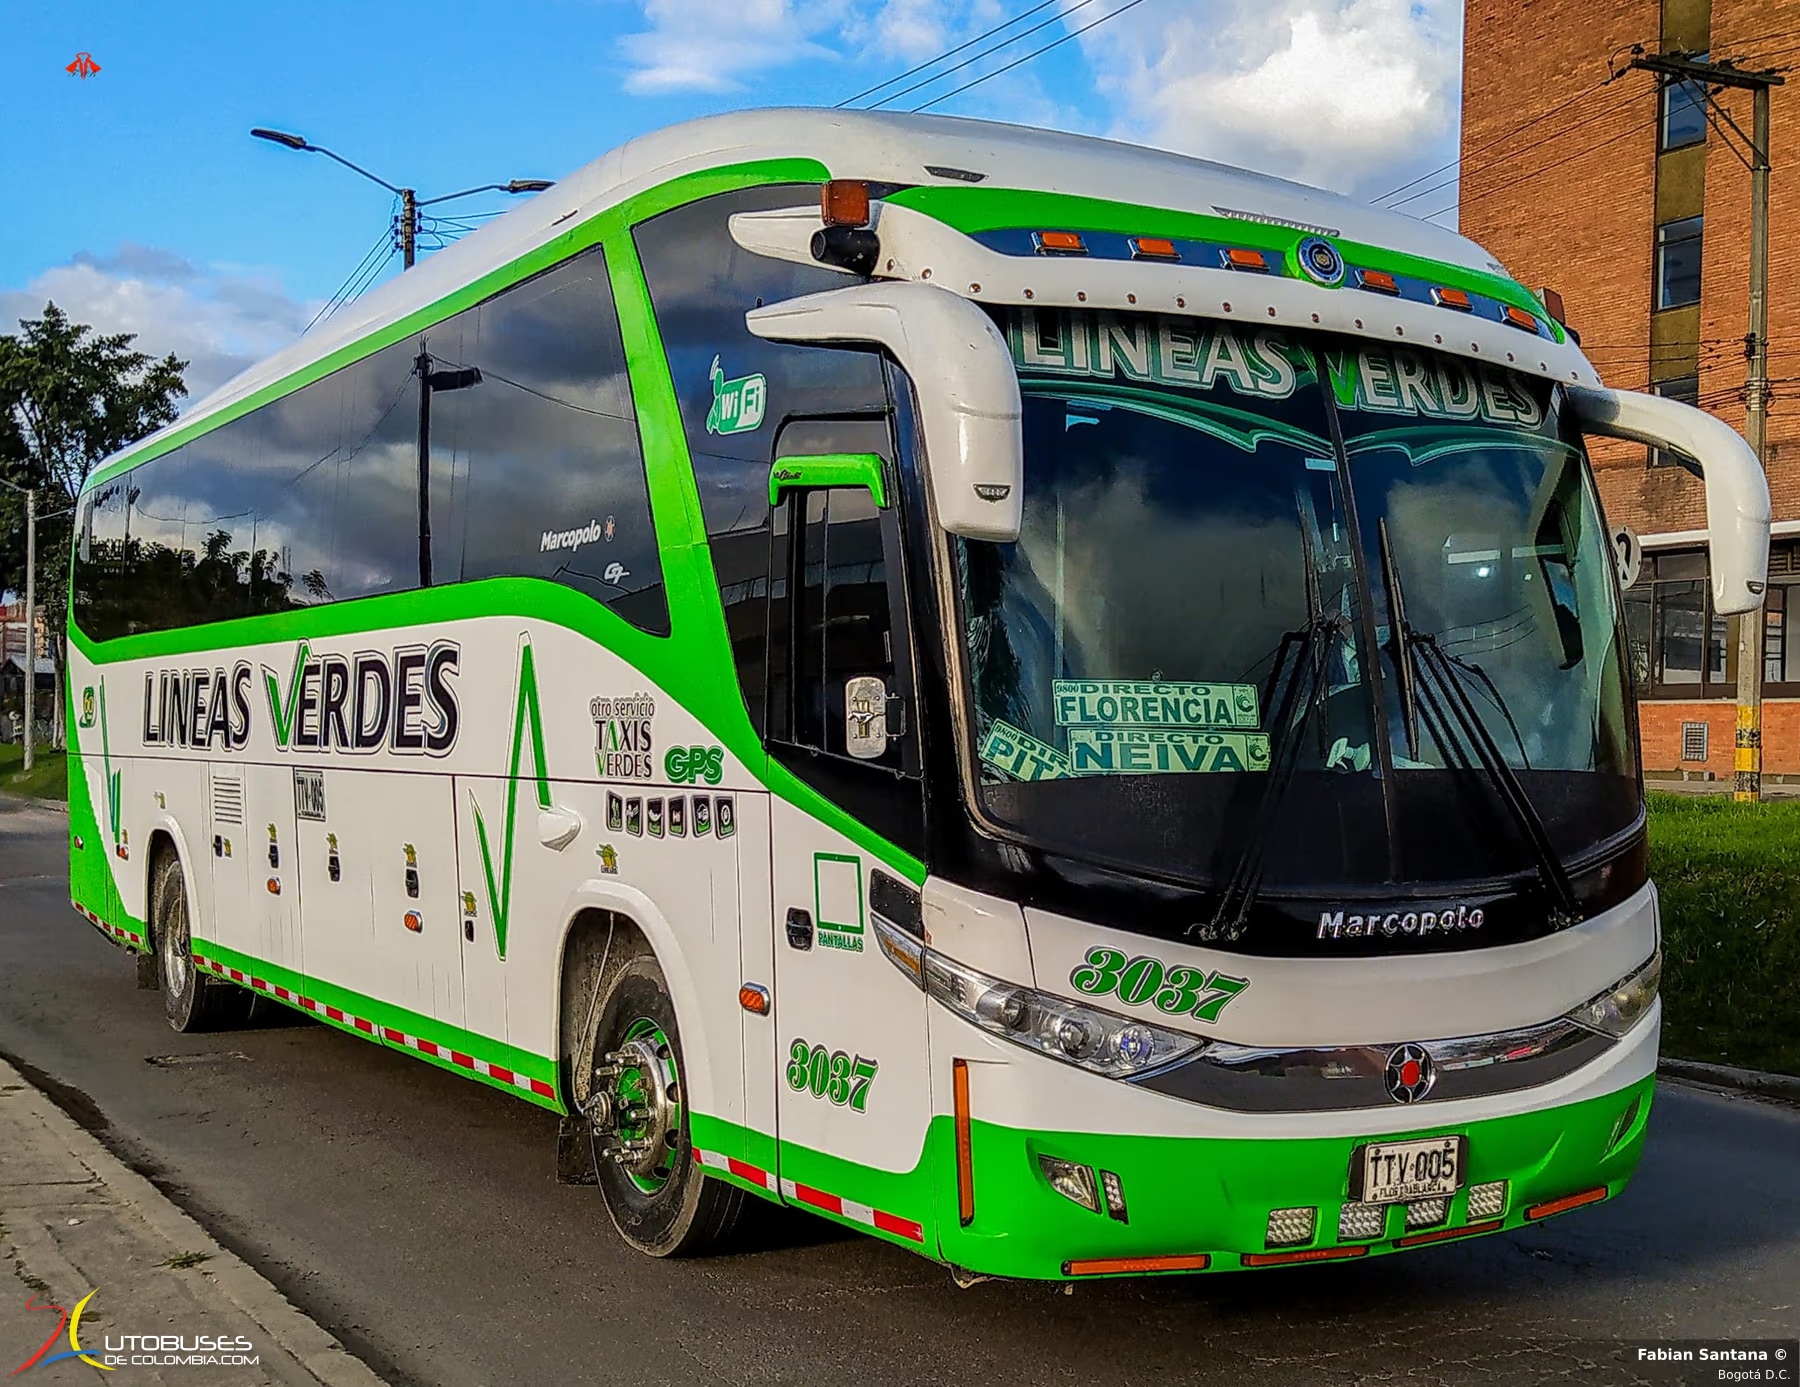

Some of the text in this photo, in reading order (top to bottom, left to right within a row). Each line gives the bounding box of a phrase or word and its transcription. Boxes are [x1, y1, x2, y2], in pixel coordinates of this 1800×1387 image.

[1012, 308, 1543, 430] LINEAS VERDES
[540, 519, 601, 552] Marcopolo
[143, 639, 461, 757] LINEAS VERDES
[1080, 684, 1212, 696] DIRECTO
[591, 697, 655, 717] otro servicio
[1060, 696, 1233, 724] FLORENCIA
[595, 720, 652, 752] TAXIS
[1095, 731, 1224, 745] DIRECTO
[597, 750, 652, 778] VERDES
[665, 746, 723, 784] GPS
[985, 736, 1070, 780] PIT
[1017, 736, 1069, 771] DIR
[1074, 743, 1248, 772] NEIVA
[1317, 905, 1484, 938] Marcopolo
[817, 930, 864, 952] PANTALLAS
[1070, 945, 1251, 1024] 3037
[787, 1038, 879, 1114] 3037
